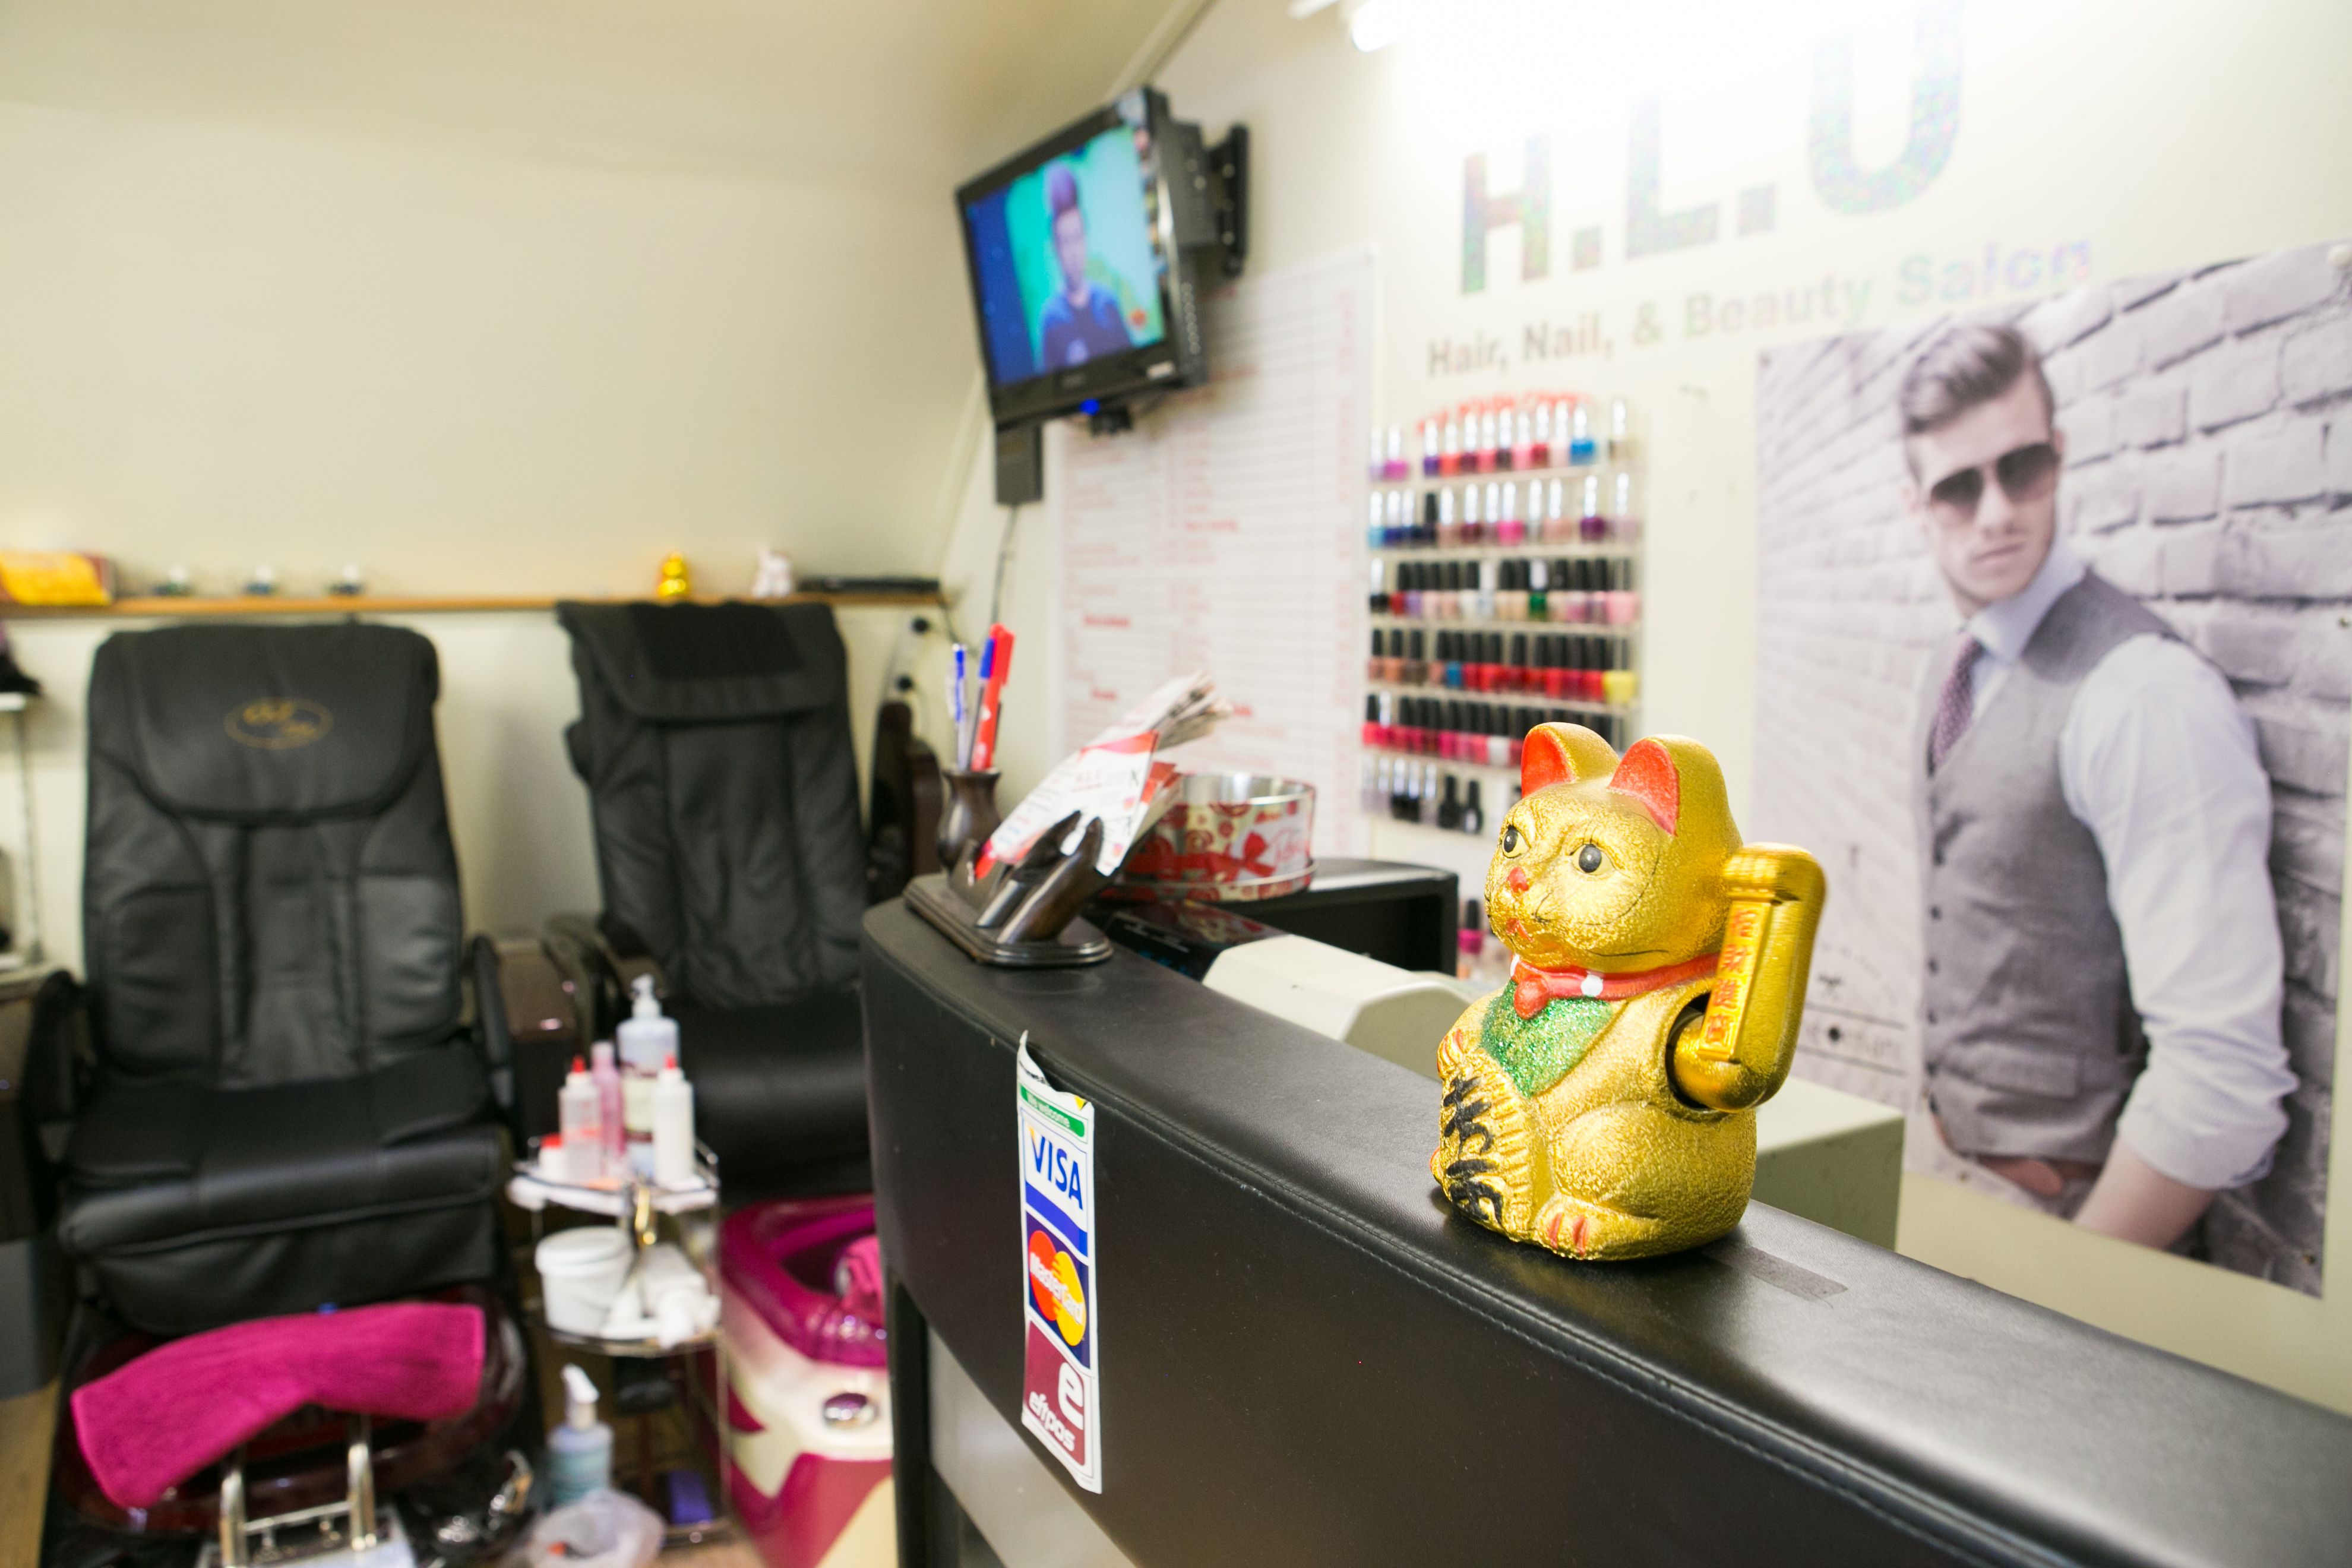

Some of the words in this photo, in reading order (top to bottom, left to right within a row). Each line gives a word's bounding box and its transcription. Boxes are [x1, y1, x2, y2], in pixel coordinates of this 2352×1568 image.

[1427, 331, 1507, 378] Hair,
[1522, 312, 1613, 363] Nail,
[1631, 298, 1663, 347] &
[1683, 273, 1874, 339] Beauty
[1898, 240, 2091, 307] Salon
[1028, 1123, 1084, 1211] VISA
[1029, 1251, 1084, 1326] MasterCard
[1029, 1391, 1076, 1452] eftpos
[1058, 1362, 1085, 1431] e
